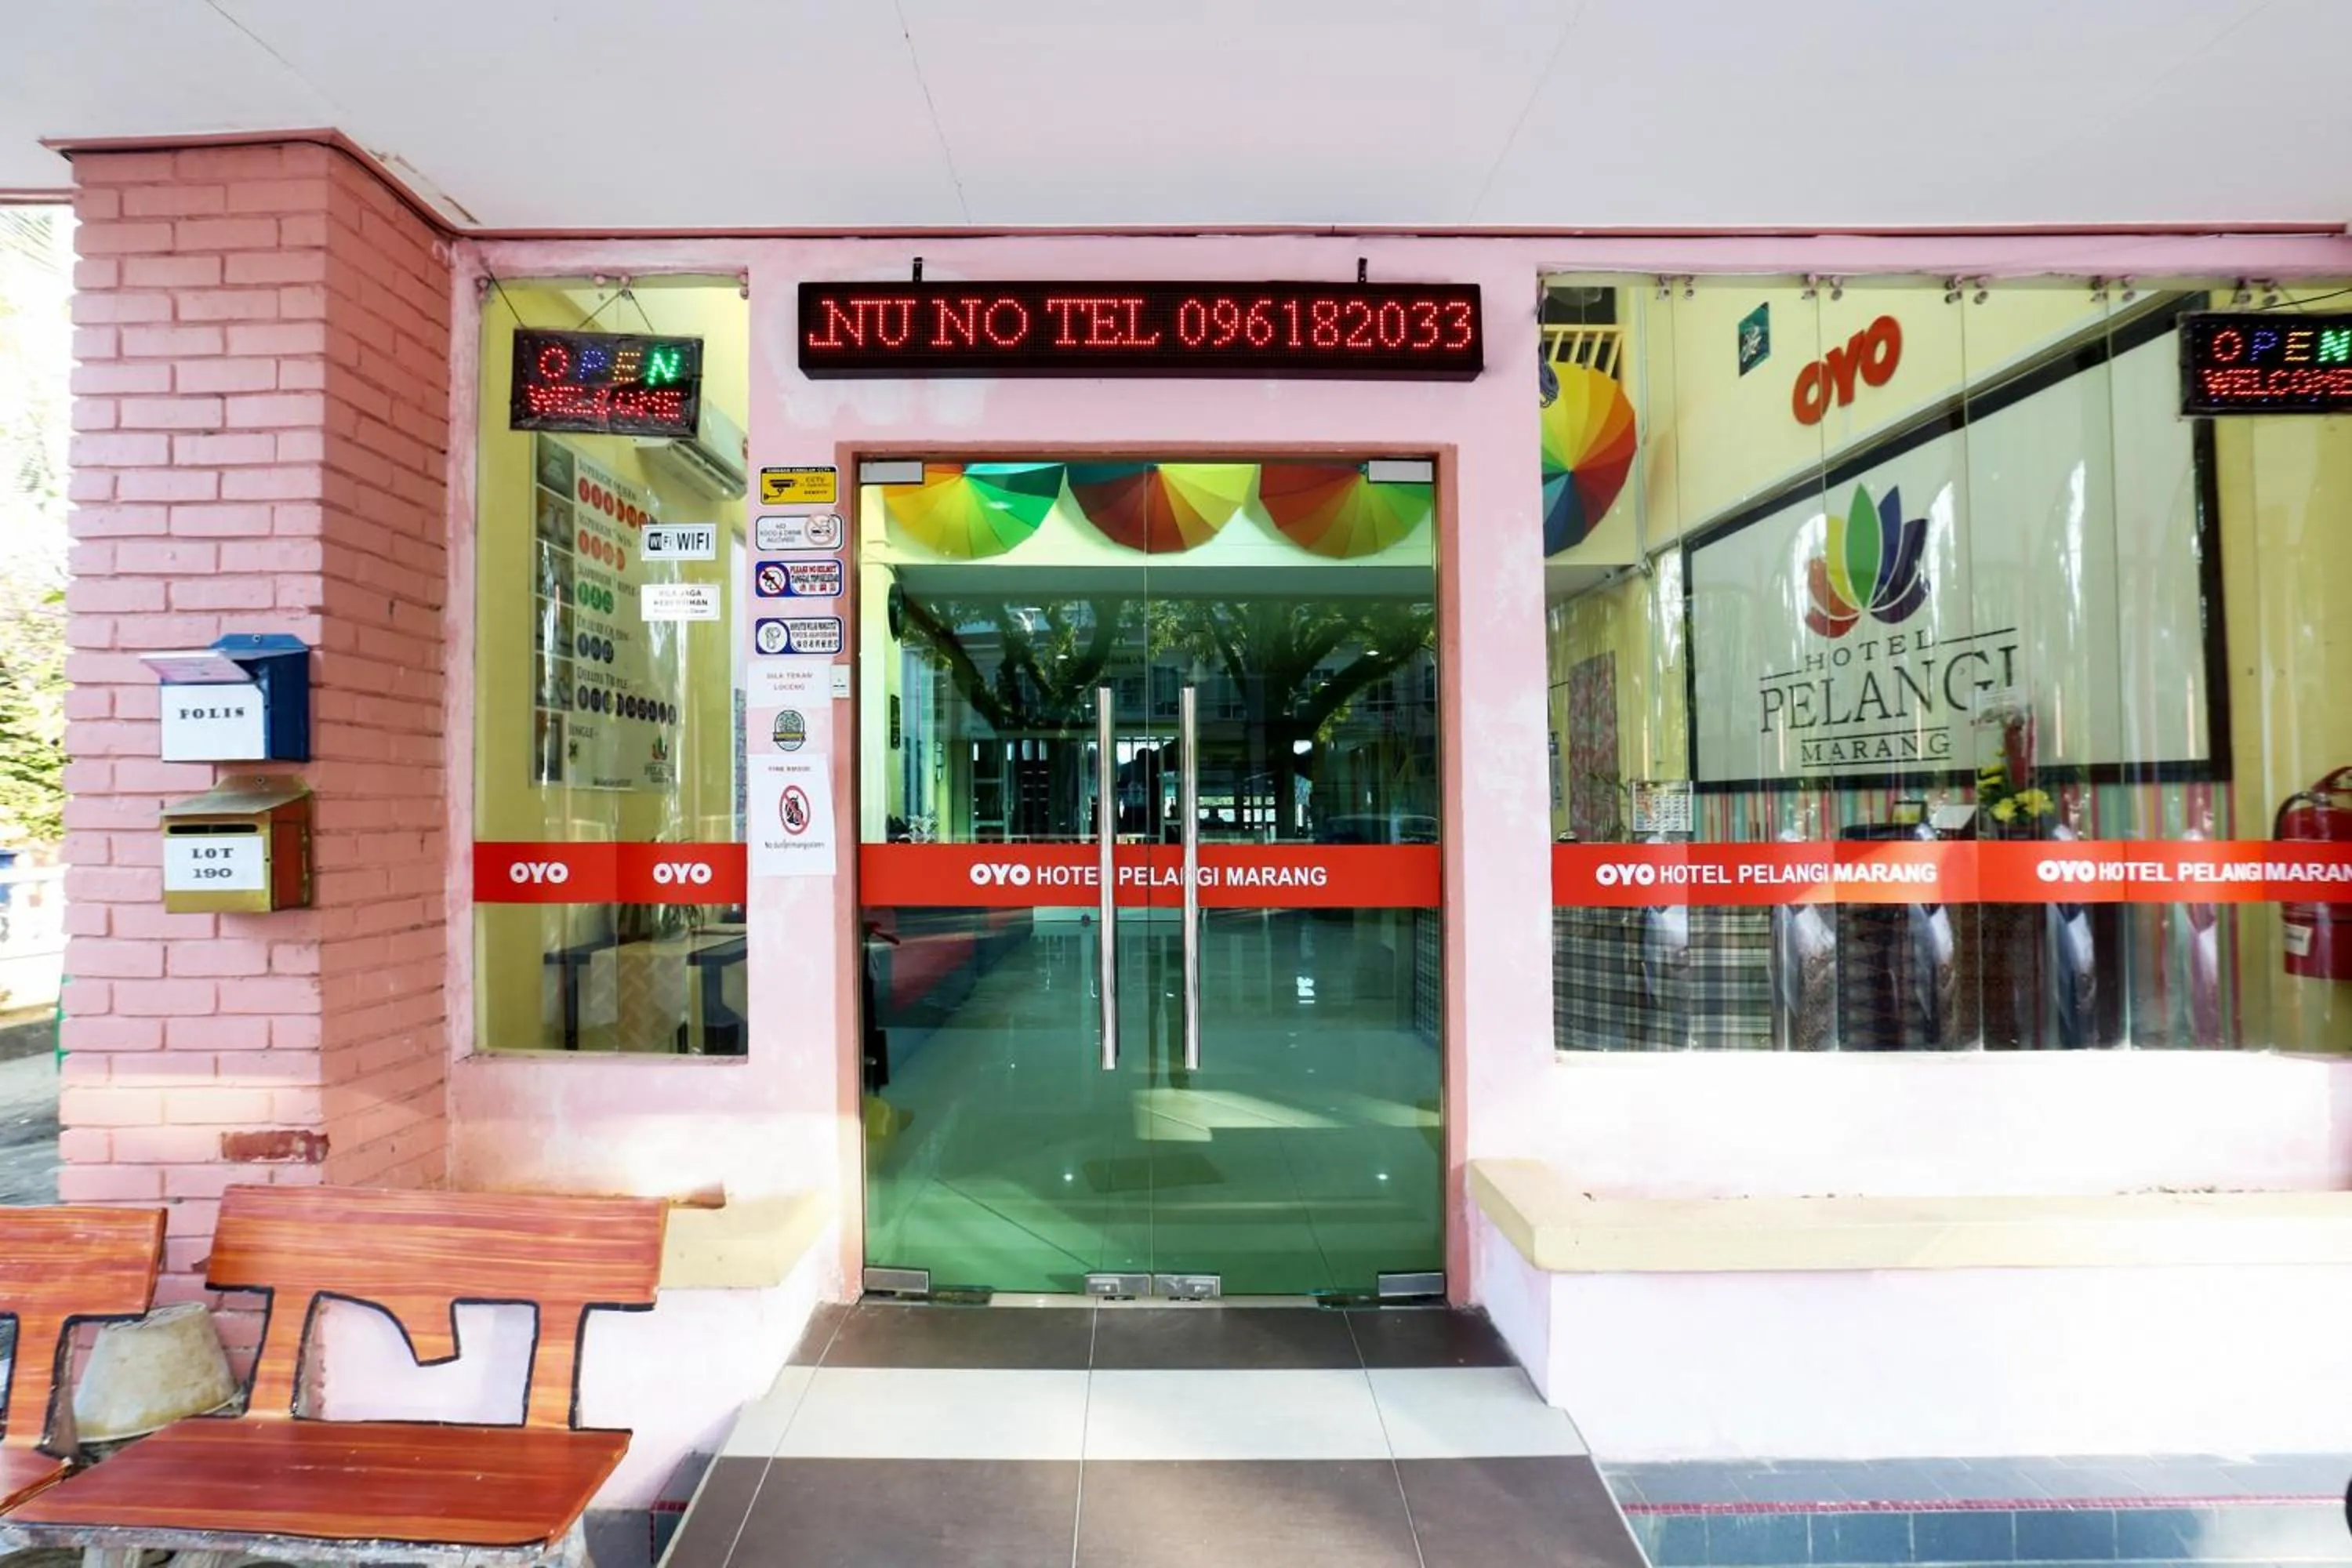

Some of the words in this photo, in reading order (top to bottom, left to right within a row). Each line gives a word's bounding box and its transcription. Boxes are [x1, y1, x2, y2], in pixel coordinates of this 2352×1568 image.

[809, 299, 916, 346] NU
[931, 299, 1029, 345] NO
[1047, 298, 1160, 346] TEL
[1179, 299, 1472, 348] 096182033
[2212, 330, 2352, 362] OPEN
[539, 347, 680, 384] OPEN
[1792, 315, 1902, 426] OYO
[677, 532, 710, 551] WIFI
[1805, 629, 1936, 673] HOTEL
[1759, 644, 2019, 734] PELANGI
[1802, 733, 1951, 763] MARANG
[191, 848, 234, 859] LOT
[192, 867, 234, 879] 190
[510, 862, 568, 884] OYO
[652, 863, 713, 884] OYO
[970, 863, 1030, 885] OYO
[1036, 866, 1099, 885] HOTE
[1119, 866, 1219, 886] PELAGI
[1226, 866, 1327, 886] MARANG
[1595, 864, 1654, 885] OYO
[1660, 864, 1731, 884] HOTEL
[1738, 864, 1829, 884] PELANGI
[1833, 863, 1937, 884] MARANG
[2037, 860, 2096, 883] OYO
[2099, 862, 2172, 883] HOTEL
[2177, 862, 2263, 883] PELANGI
